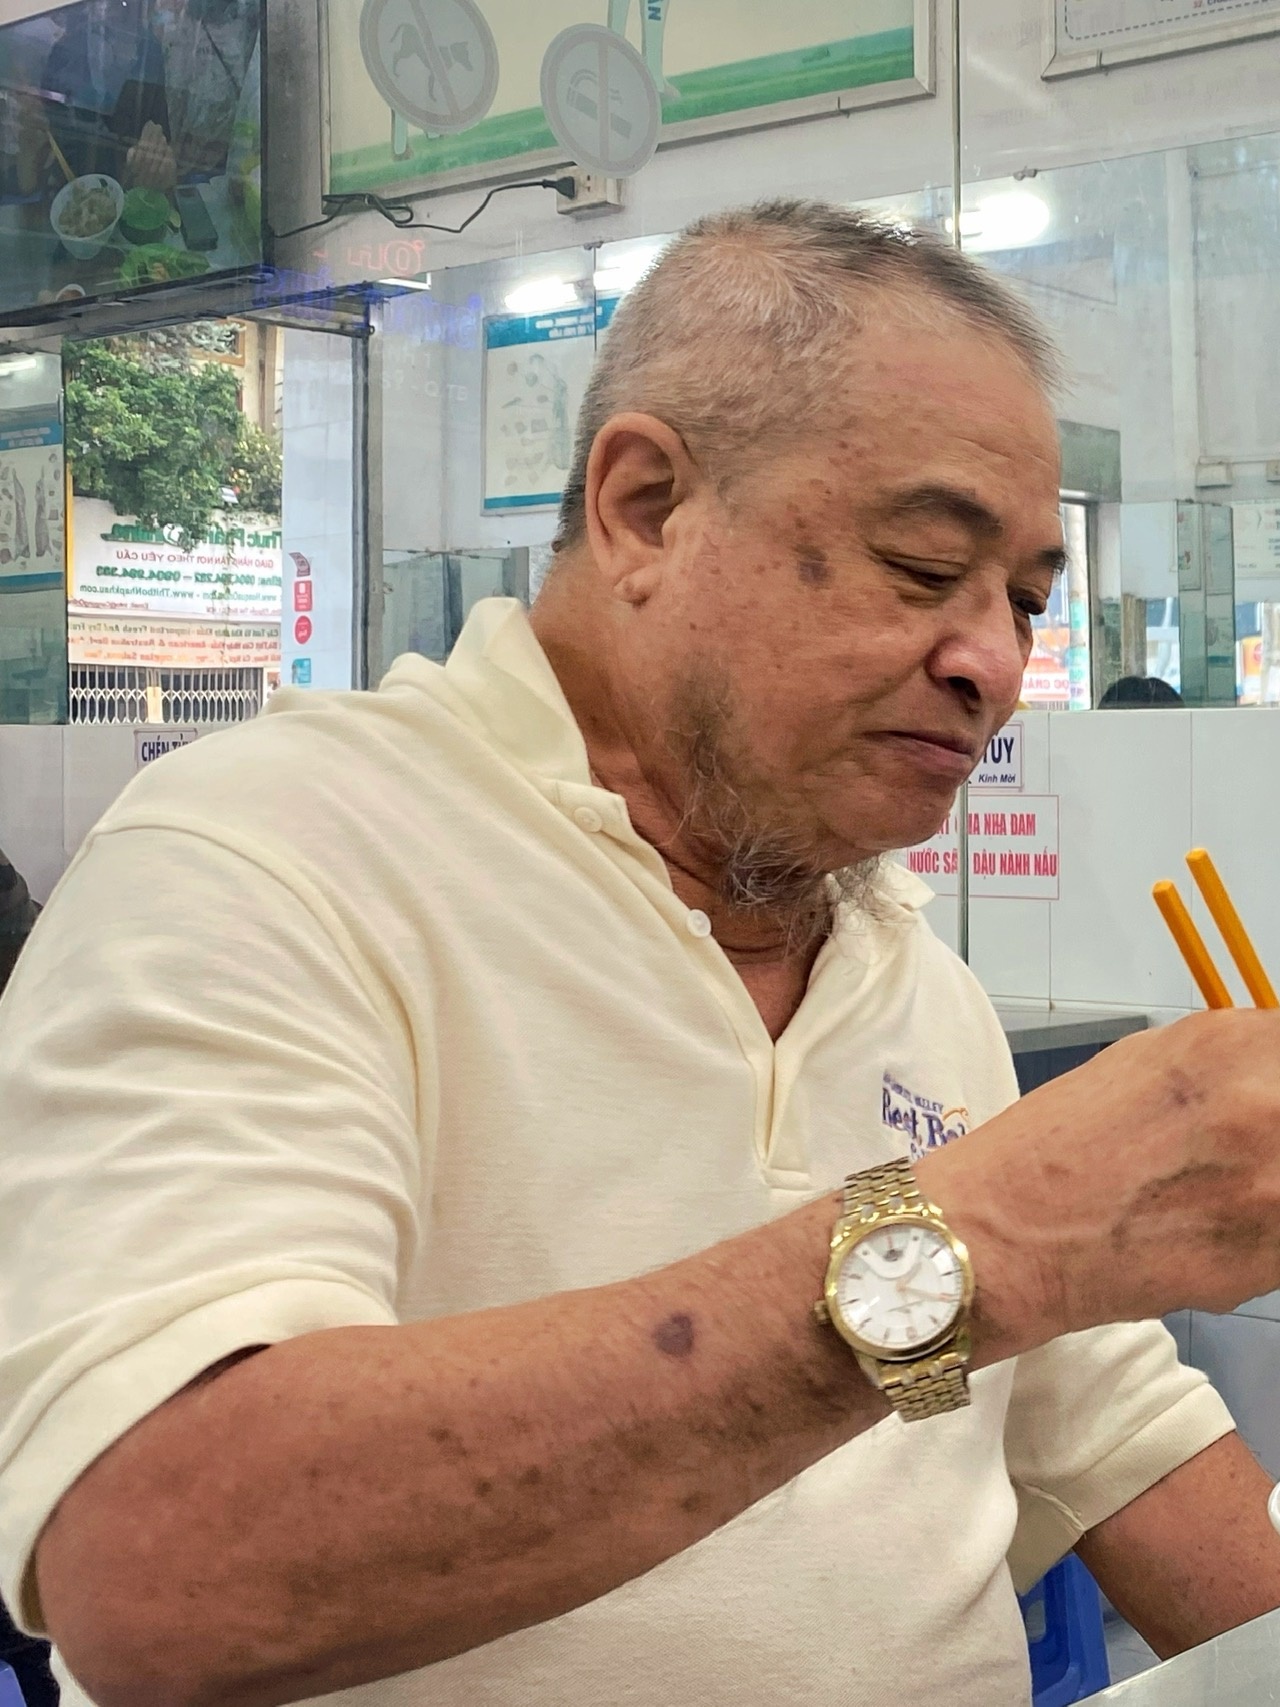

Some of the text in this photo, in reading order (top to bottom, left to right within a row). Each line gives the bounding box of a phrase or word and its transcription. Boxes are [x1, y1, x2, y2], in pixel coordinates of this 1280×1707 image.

[973, 848, 996, 880] ĐẬU
[1000, 849, 1031, 876] NÀNH
[1034, 845, 1057, 877] NẤU
